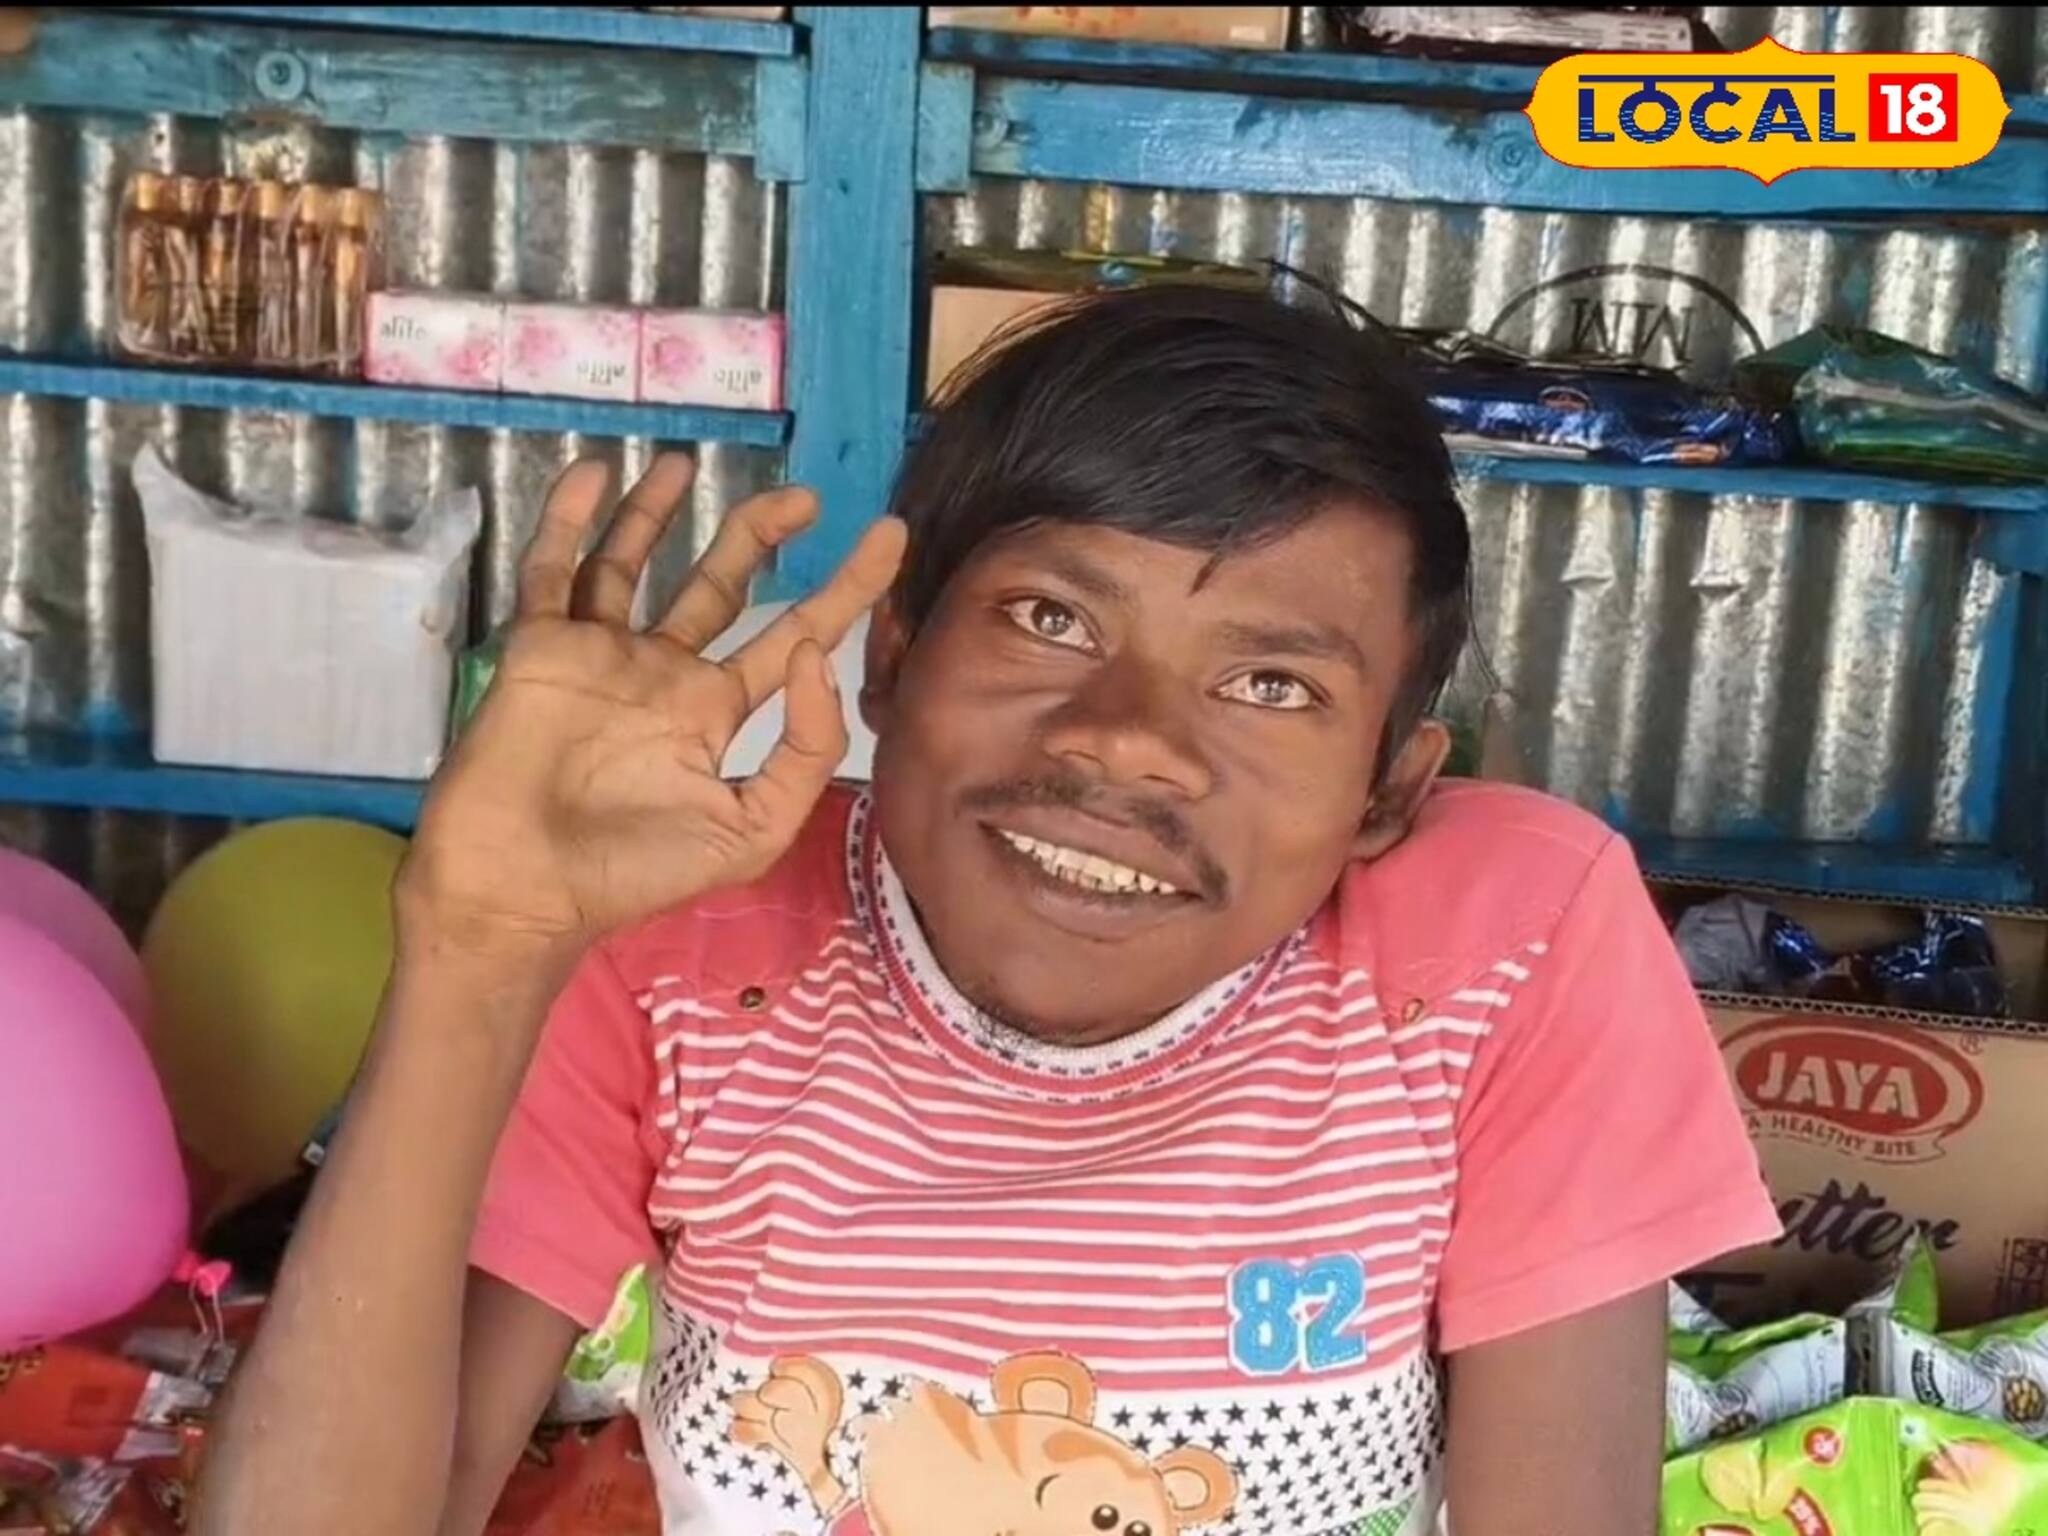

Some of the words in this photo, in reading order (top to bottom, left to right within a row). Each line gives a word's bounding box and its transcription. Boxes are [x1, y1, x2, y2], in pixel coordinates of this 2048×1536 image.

[1757, 1051, 1919, 1118] JAYA
[1772, 1115, 1866, 1150] HEALTHY
[1229, 1252, 1366, 1375] 82
